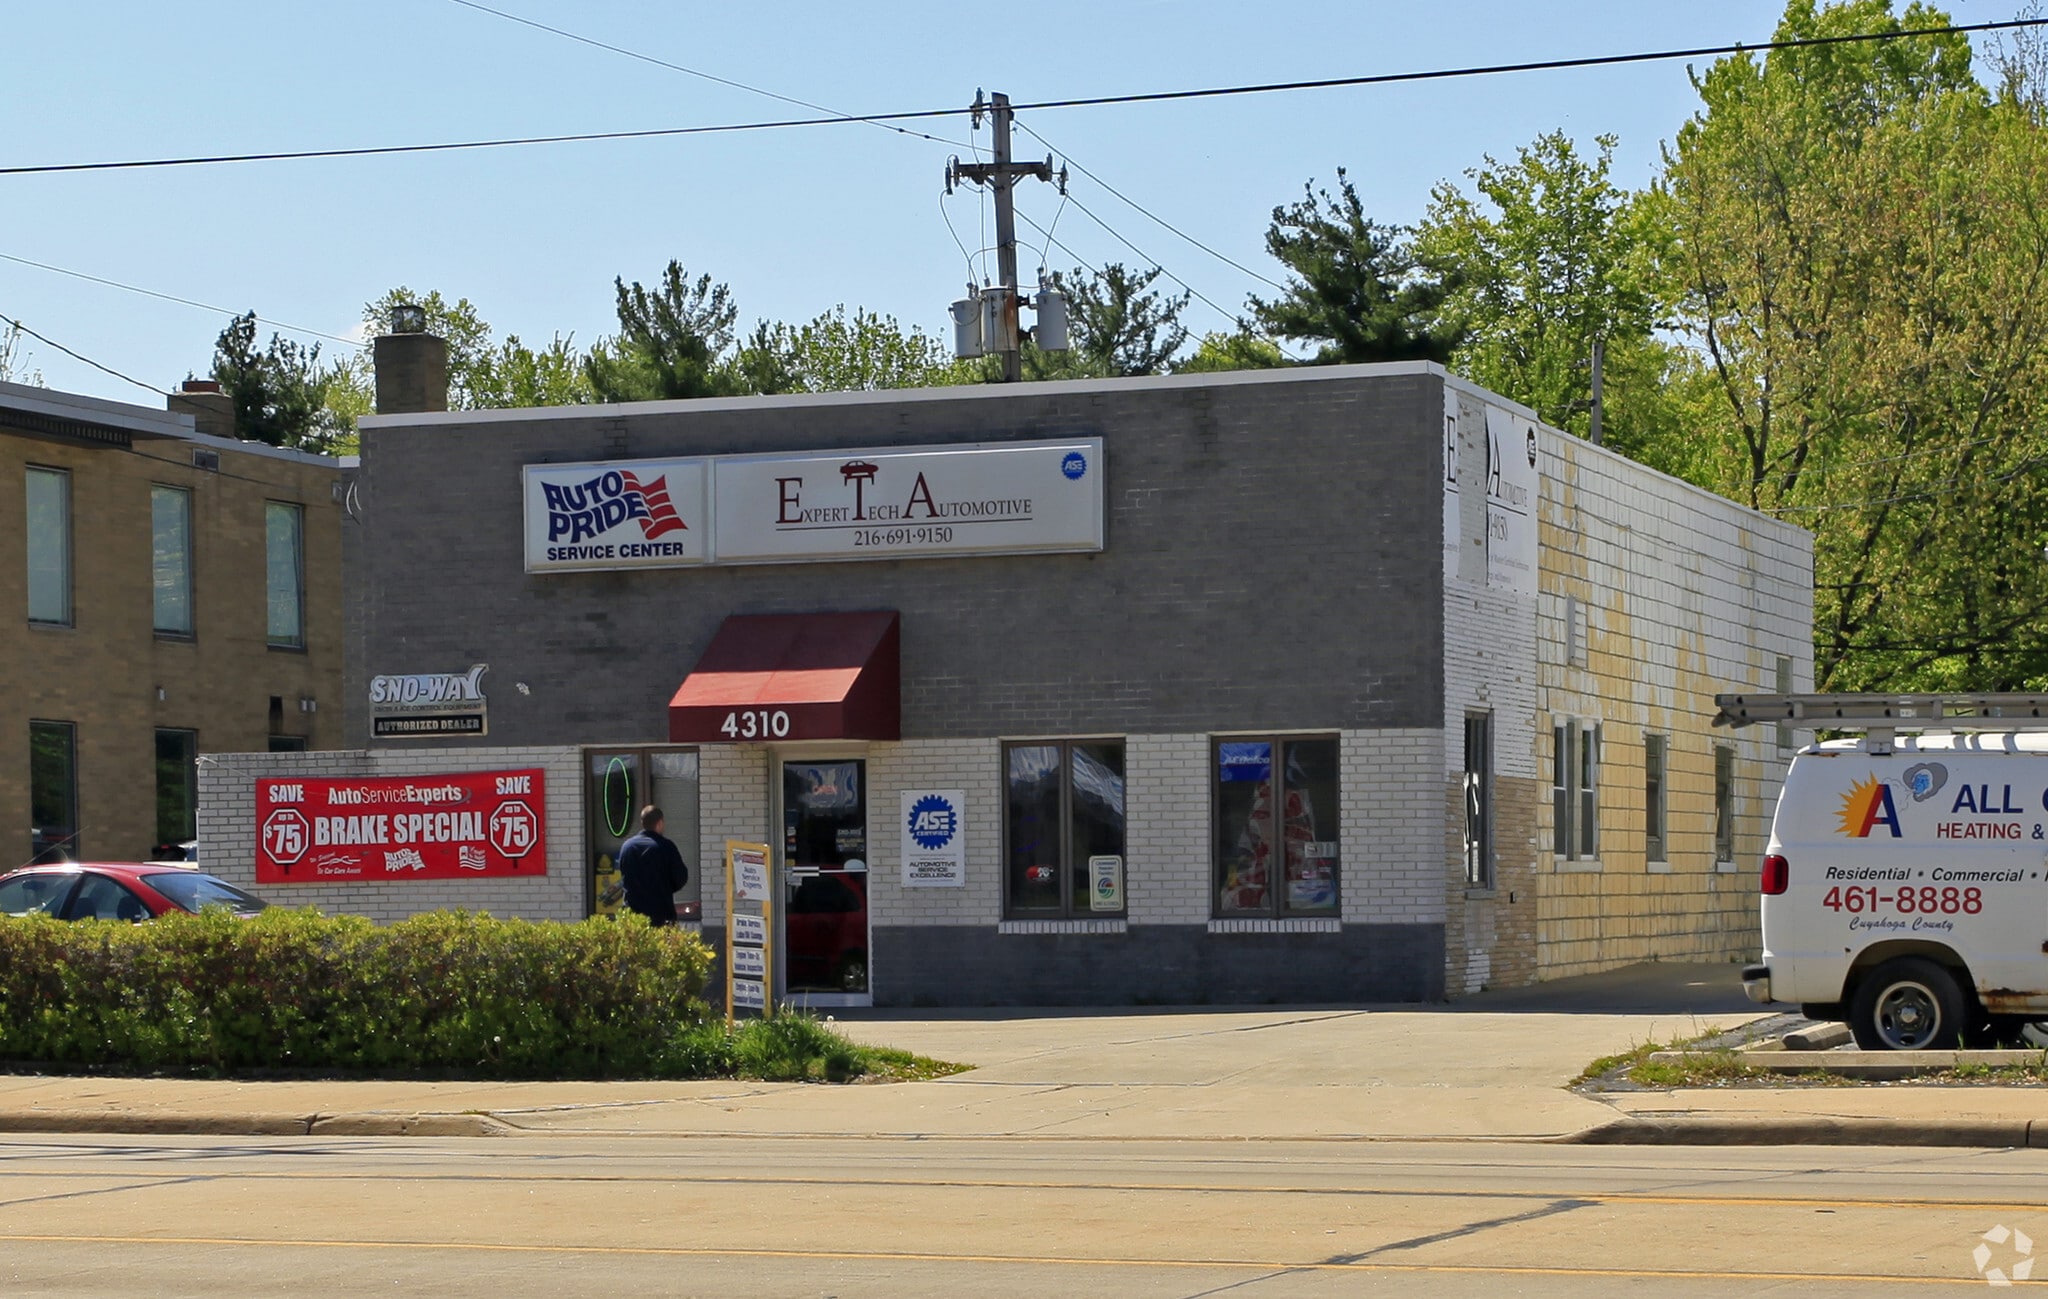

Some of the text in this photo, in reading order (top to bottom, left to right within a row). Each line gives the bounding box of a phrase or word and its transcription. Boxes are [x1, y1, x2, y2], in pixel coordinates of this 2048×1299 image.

[1065, 460, 1083, 471] ASE
[541, 471, 623, 511] AUTO
[901, 471, 1032, 519] AUTOMOTIVE
[548, 492, 649, 543] PRIDE
[547, 542, 683, 561] SERVICE CENTER
[372, 667, 486, 703] SNO-WAY
[377, 719, 480, 732] AUTHORIZED DEALER
[721, 711, 790, 738] 4310
[269, 784, 304, 803] SAVE
[495, 776, 531, 795] SAVE
[1951, 784, 2024, 814] ALL
[315, 811, 485, 846] BRAKE SPECIAL
[914, 811, 949, 830] ASE
[1937, 823, 2045, 840] HEATING &
[384, 848, 410, 862] AUTO
[386, 854, 415, 872] PRIDE
[1825, 866, 2024, 882] Residential Commercial
[1823, 886, 1982, 914] 461-8888
[1849, 916, 1954, 932] Cuyahoga County
